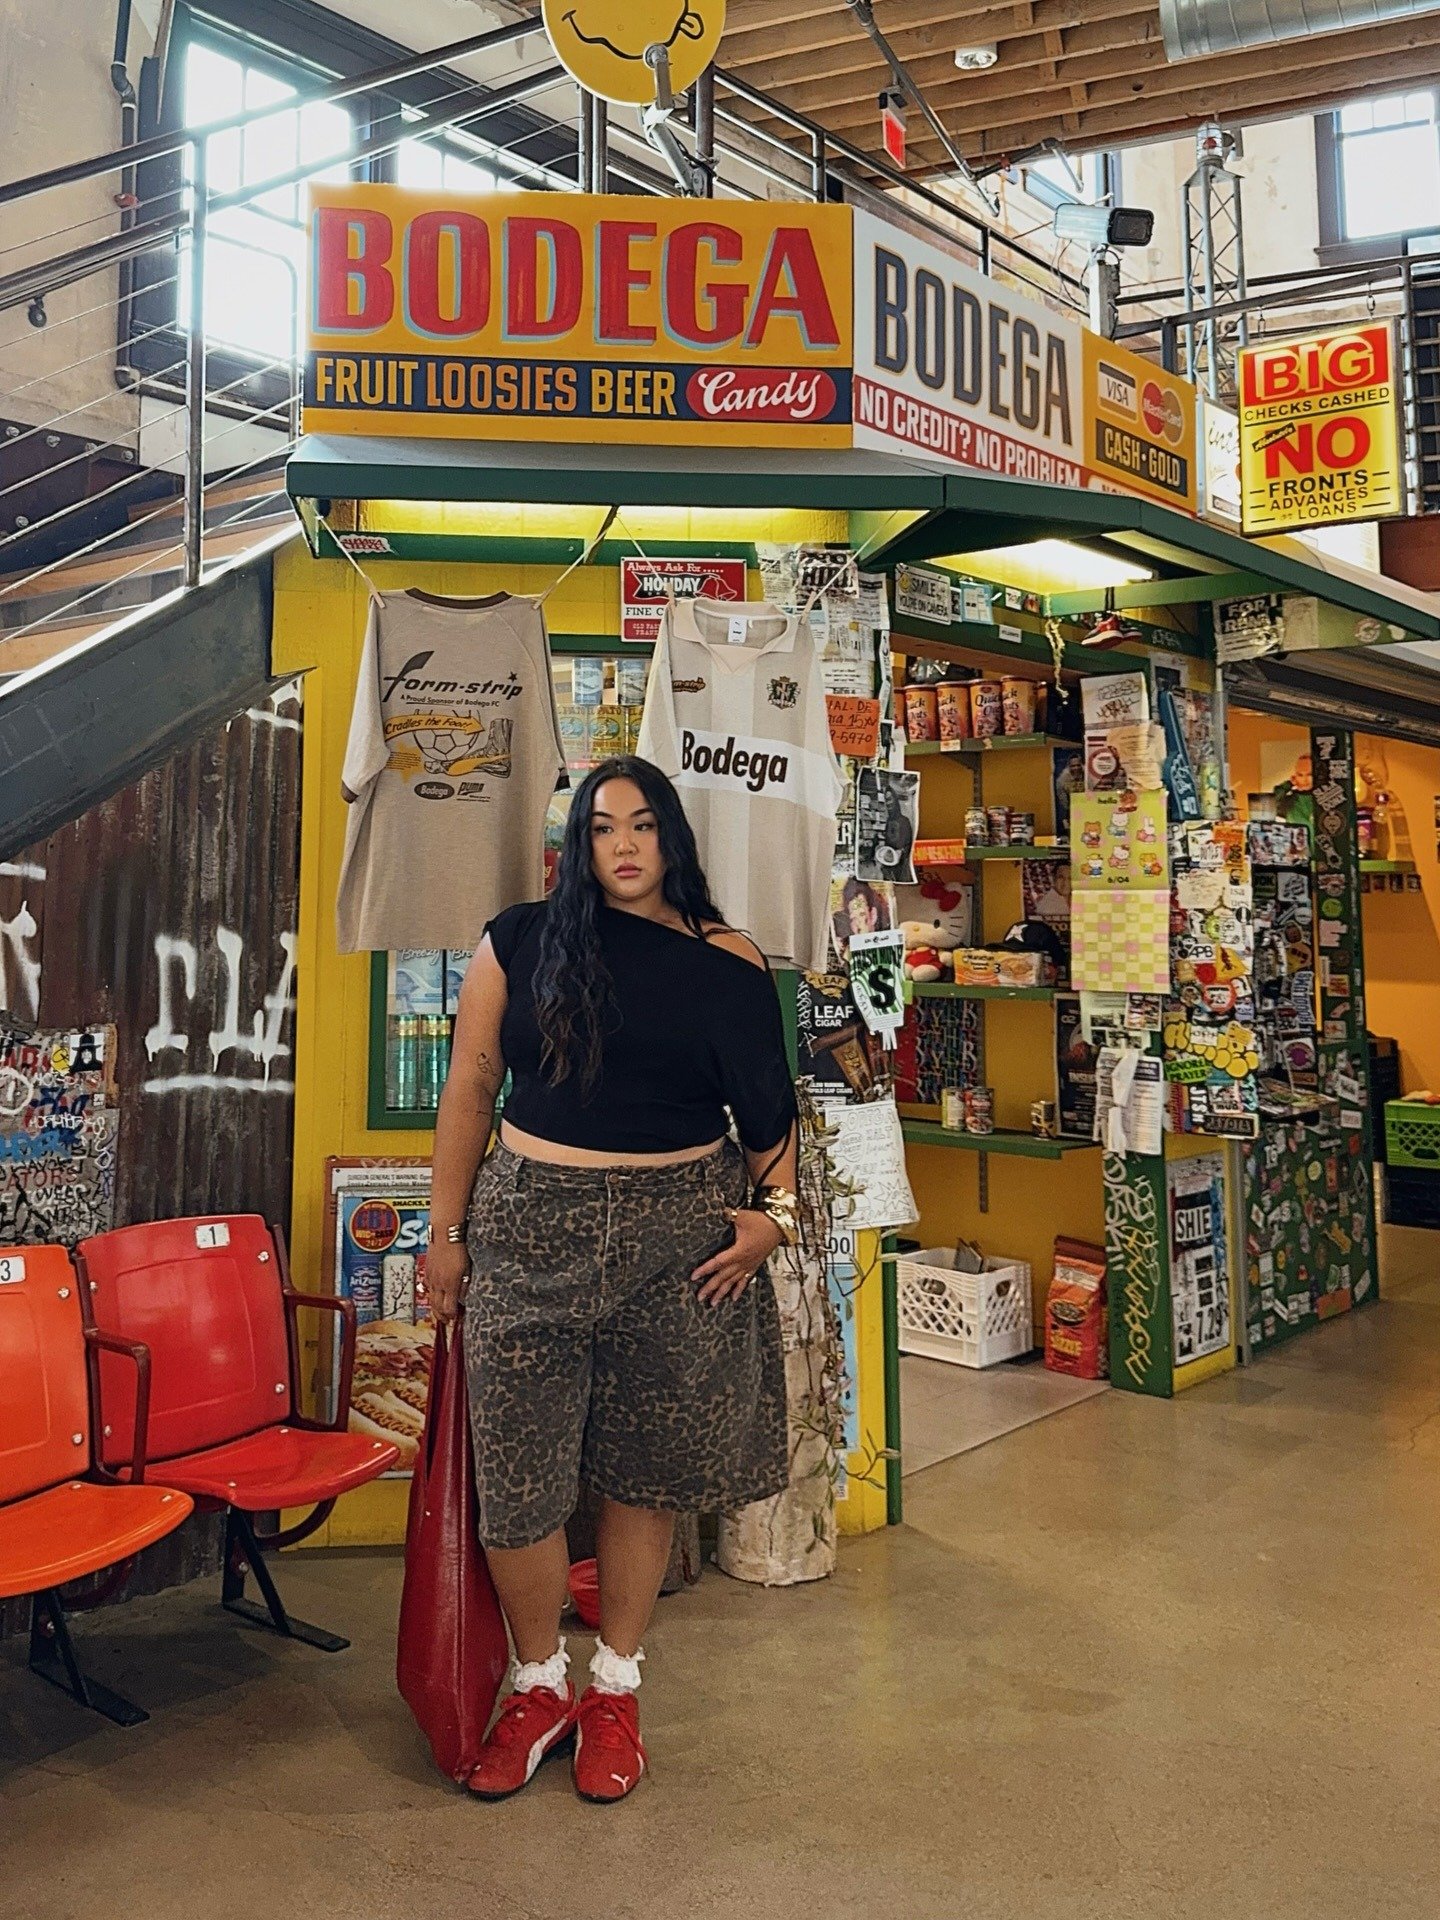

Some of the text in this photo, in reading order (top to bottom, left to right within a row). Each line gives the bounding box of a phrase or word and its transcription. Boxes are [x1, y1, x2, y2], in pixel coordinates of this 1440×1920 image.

[313, 207, 841, 350] BODEGA
[875, 245, 1073, 446] BODEGA
[1254, 335, 1374, 400] BIG
[316, 357, 821, 418] FRUIT LOOSIES BEER Candy
[1106, 379, 1129, 406] VISA
[1245, 387, 1390, 421] CHECKS CASHED
[860, 382, 888, 429] NO
[893, 392, 971, 459] CREDIT?
[975, 429, 1001, 472] NO
[1104, 428, 1180, 487] CASH GOLD
[1265, 416, 1370, 479] NO
[1269, 469, 1368, 498] FRONTS
[1270, 487, 1368, 511] ADVANCES
[1299, 502, 1357, 519] LOANS
[627, 562, 661, 572] Always
[664, 563, 683, 572] Ask
[643, 577, 700, 592] HODAY
[626, 607, 652, 616] FINE
[1228, 599, 1265, 617] FOR
[382, 651, 523, 702] form-strip
[406, 695, 426, 703] Proud
[427, 697, 455, 705] Sponsor
[465, 699, 490, 707] Bodega
[385, 718, 421, 734] Cradles
[424, 717, 440, 725] the
[682, 730, 788, 792] Bodega
[421, 785, 449, 797] Bodega
[817, 976, 843, 985] LEAF
[814, 1005, 853, 1019] LEAF
[815, 1019, 842, 1027] CIGAR
[208, 1226, 216, 1245] 1
[0, 1260, 10, 1281] 3
